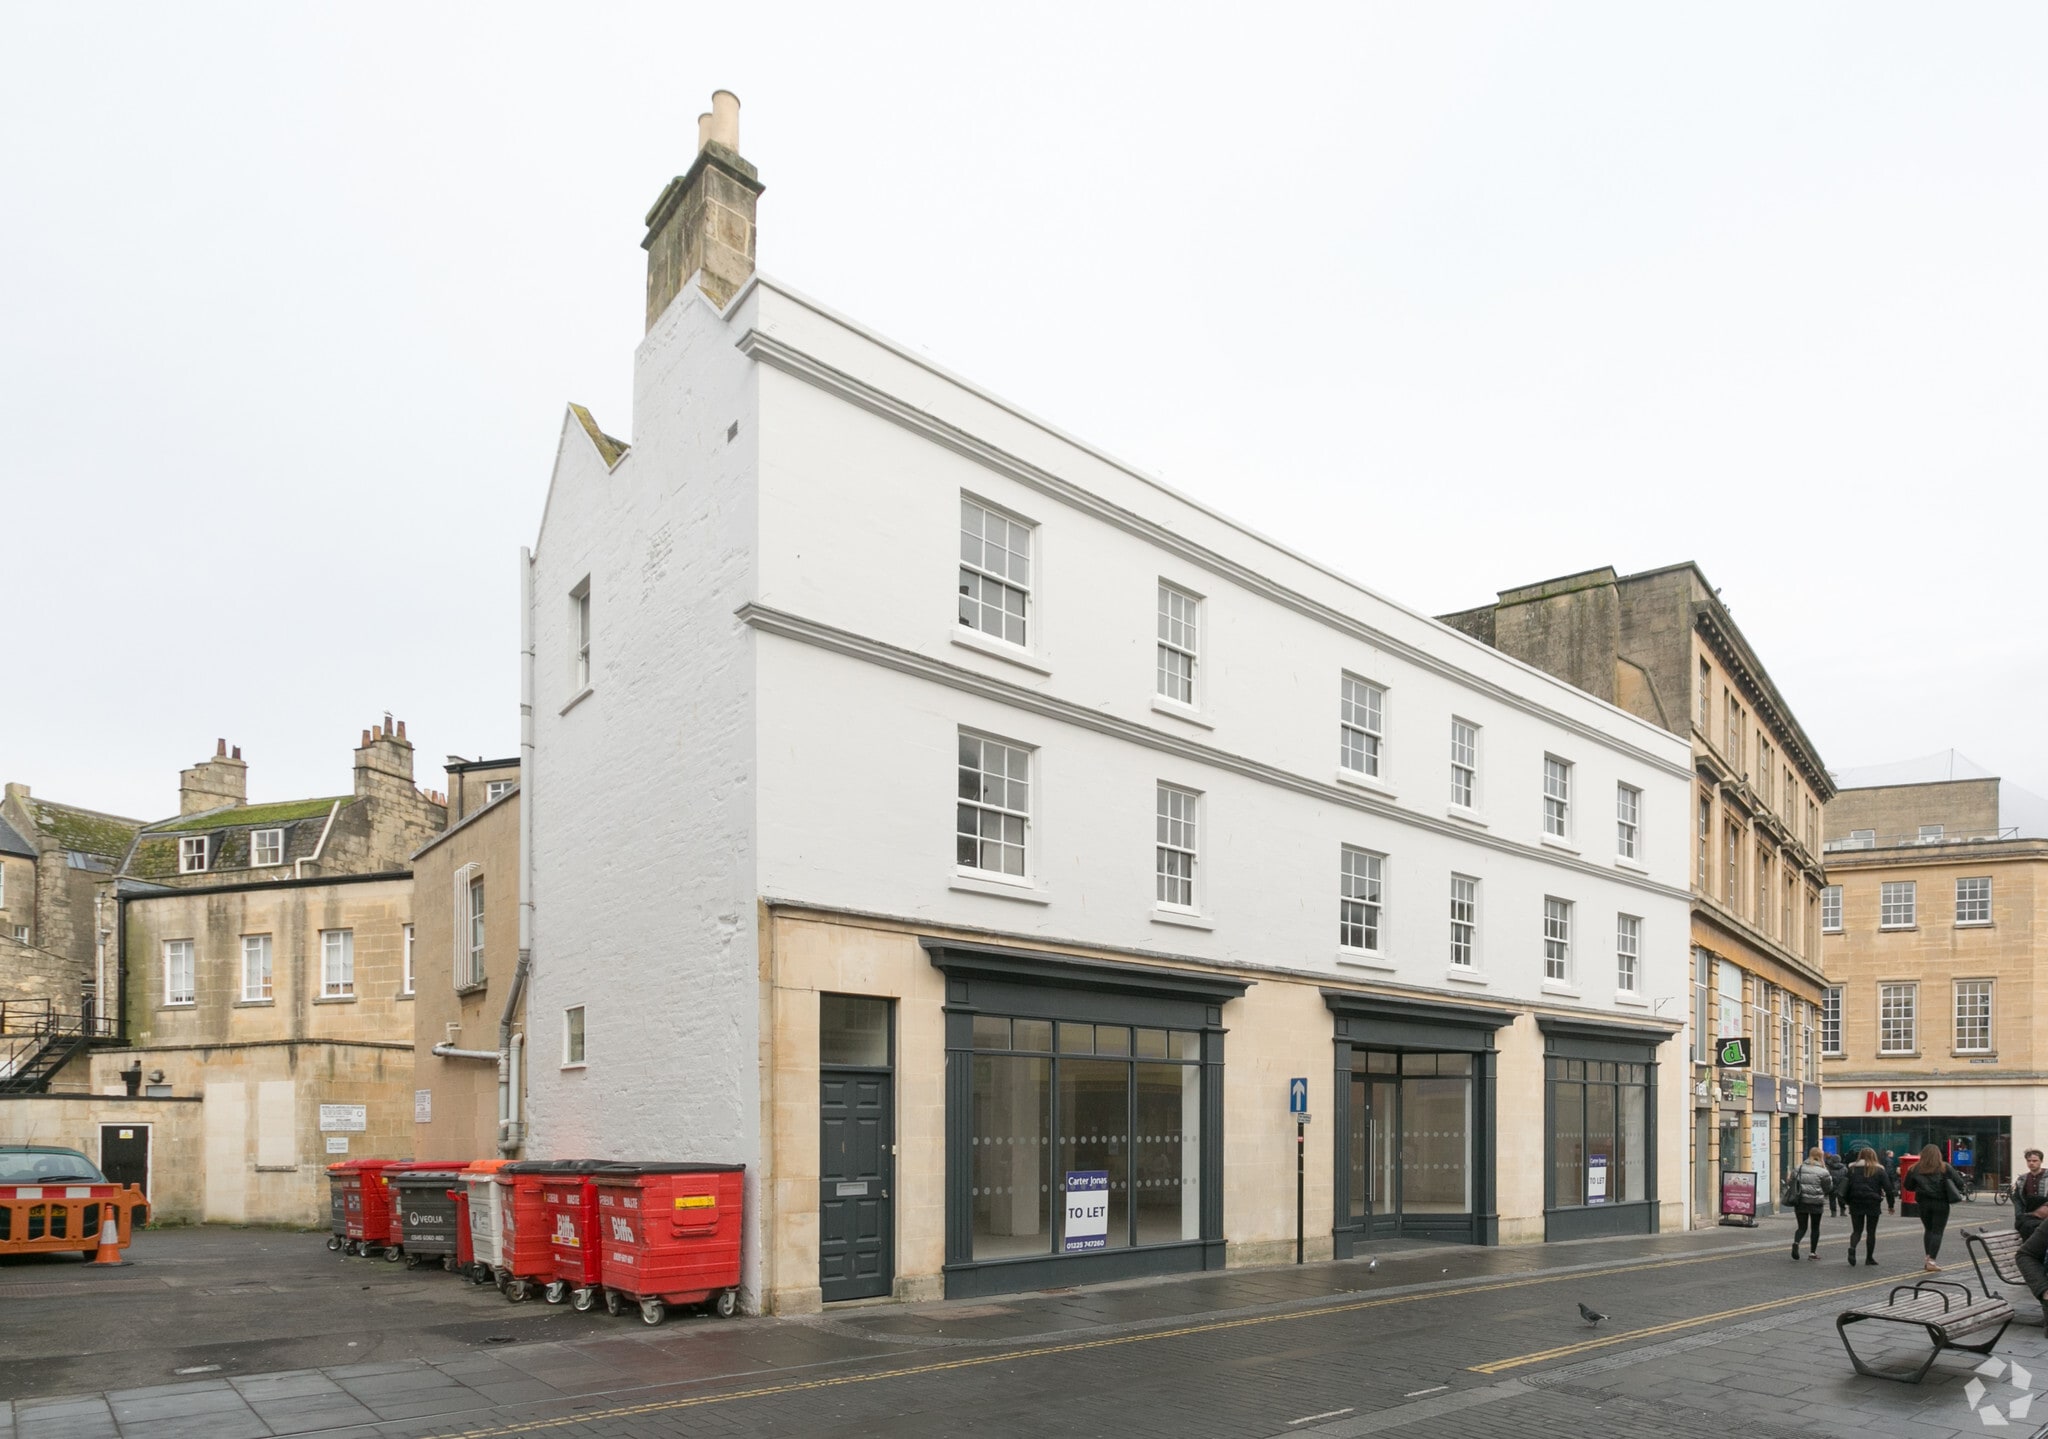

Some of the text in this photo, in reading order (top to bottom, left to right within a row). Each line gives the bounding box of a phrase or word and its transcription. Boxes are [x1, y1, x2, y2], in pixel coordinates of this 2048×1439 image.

[1865, 1091, 1928, 1112] METRO
[1892, 1104, 1928, 1112] BANK
[1068, 1176, 1108, 1187] Carter Jonas
[1068, 1206, 1105, 1219] TO LET
[420, 1215, 443, 1224] VEOLIA
[611, 1216, 634, 1243] Biffa
